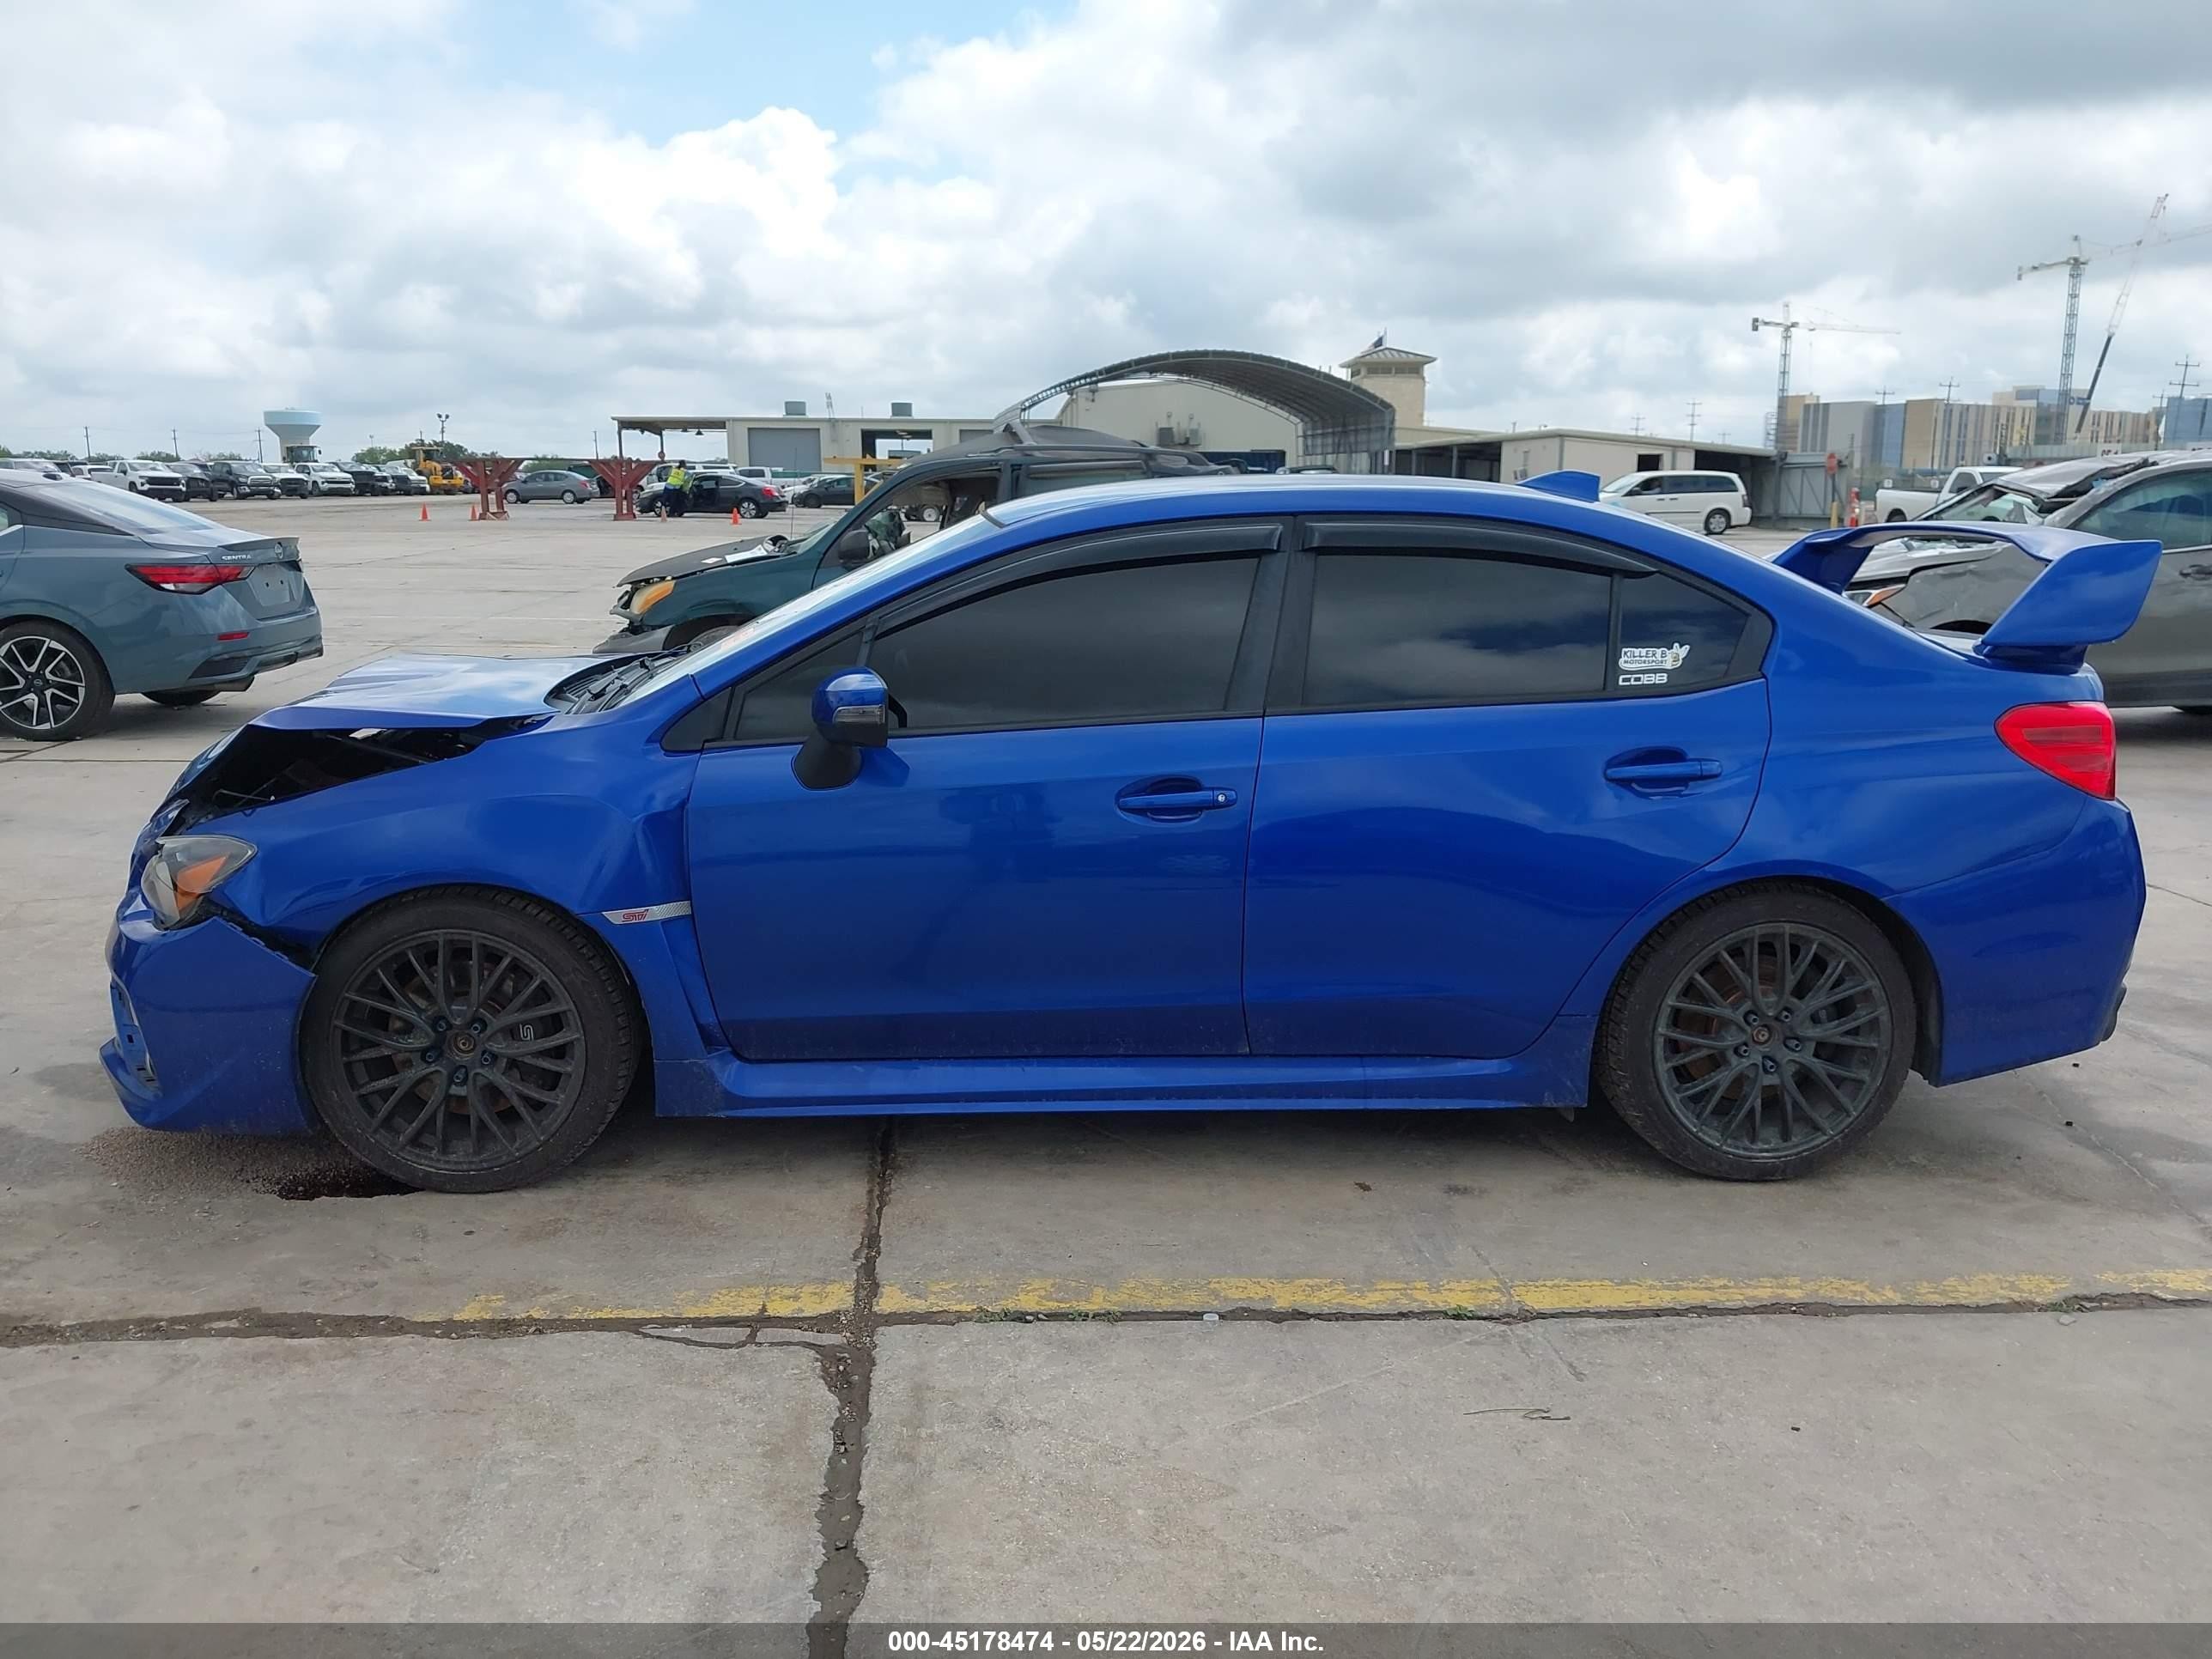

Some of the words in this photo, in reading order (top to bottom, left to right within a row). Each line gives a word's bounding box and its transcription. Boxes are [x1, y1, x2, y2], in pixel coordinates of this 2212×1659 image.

[1623, 650, 1657, 659] KILLER
[1661, 650, 1668, 659] B
[1619, 672, 1668, 685] COBB
